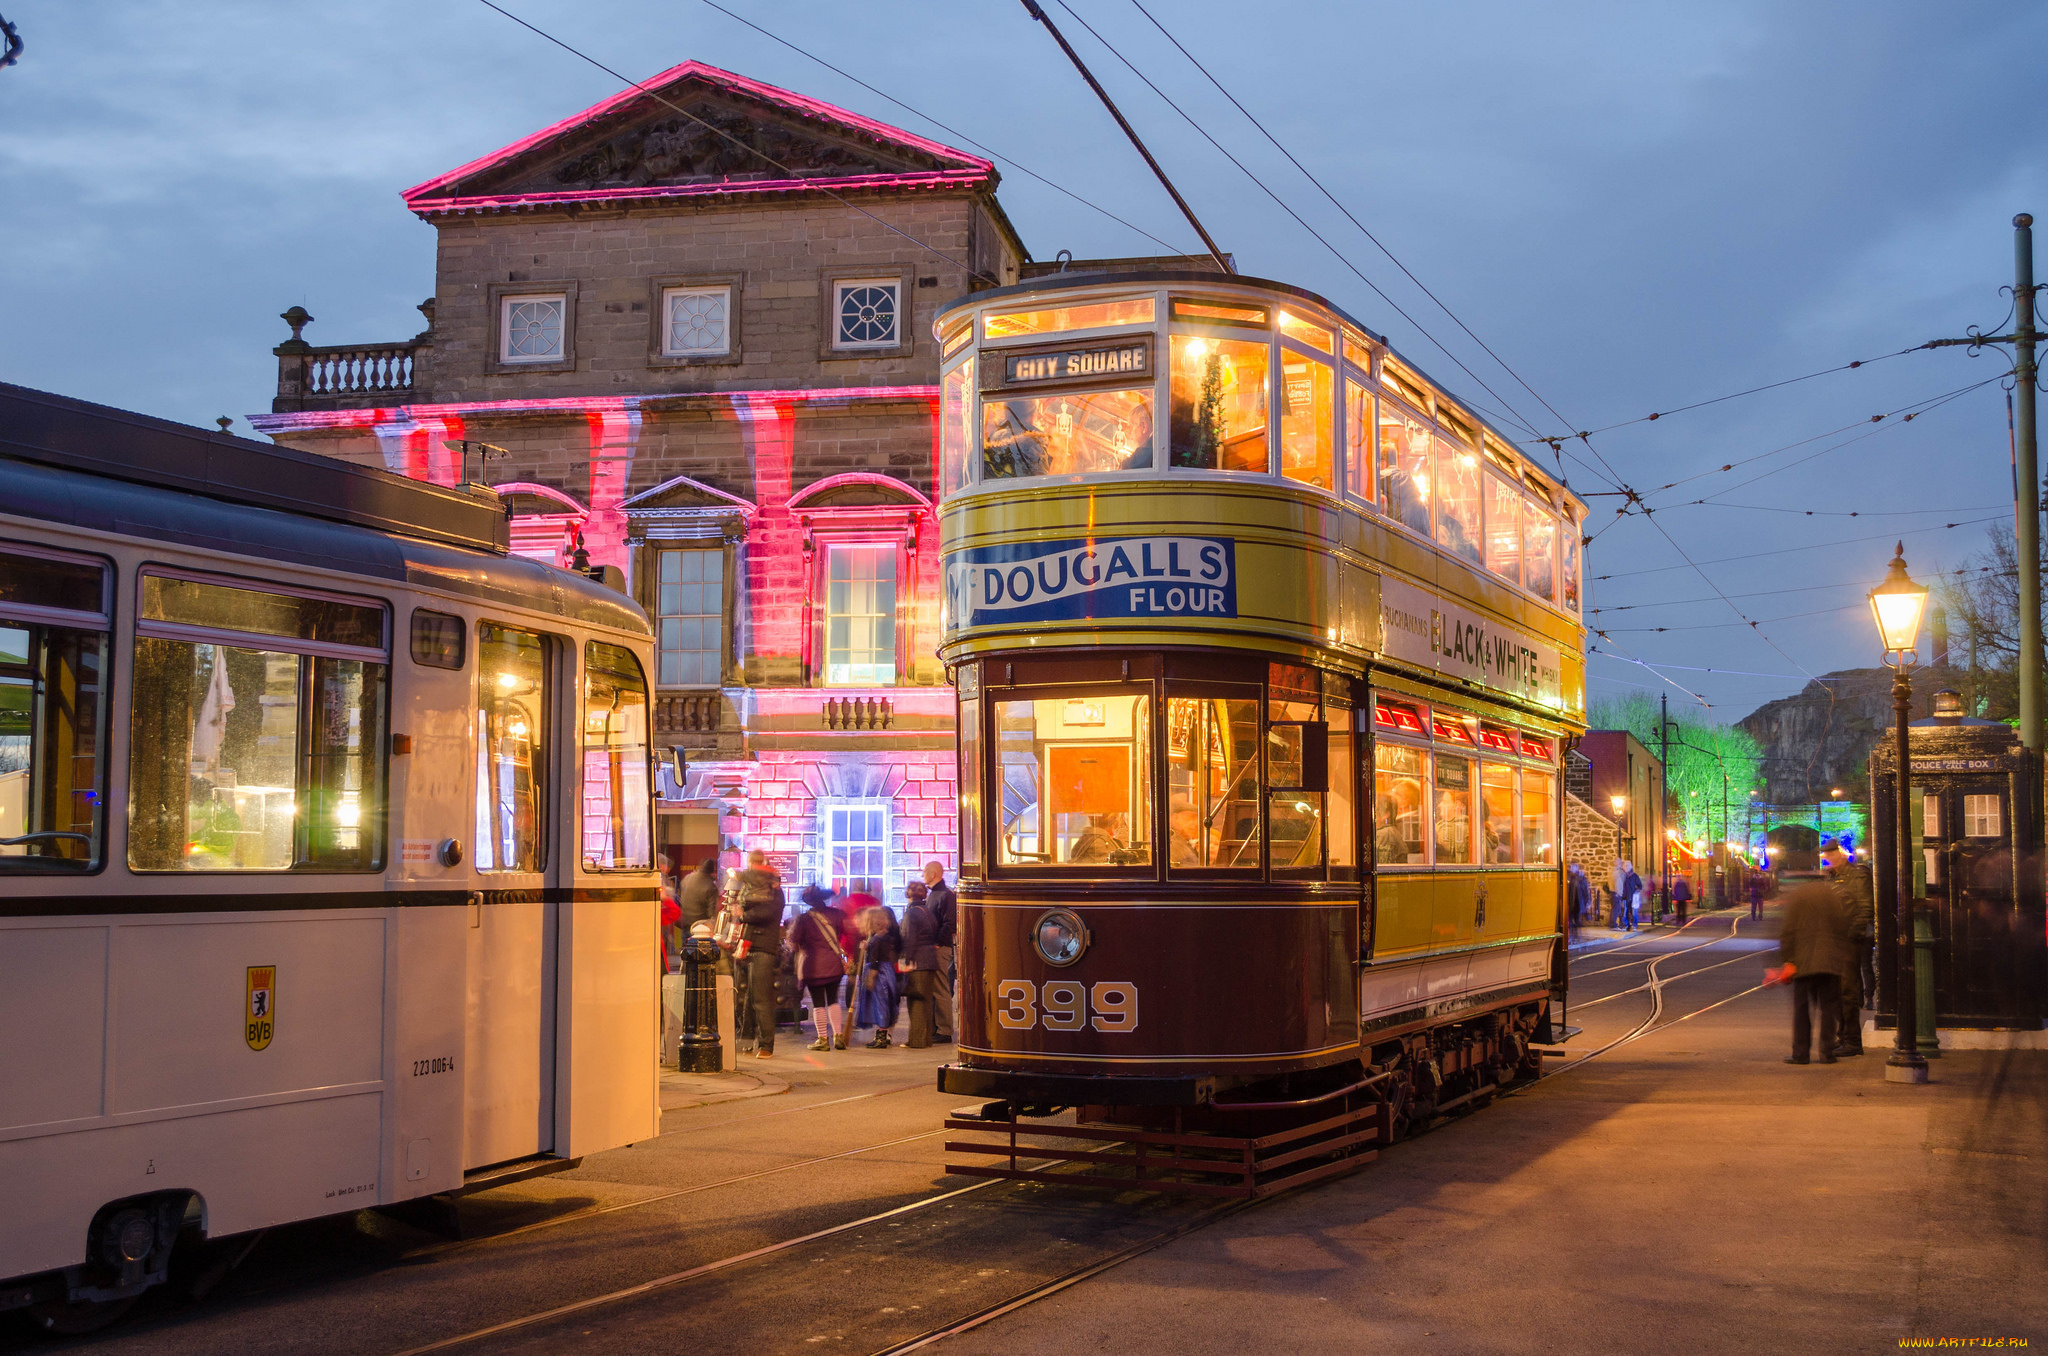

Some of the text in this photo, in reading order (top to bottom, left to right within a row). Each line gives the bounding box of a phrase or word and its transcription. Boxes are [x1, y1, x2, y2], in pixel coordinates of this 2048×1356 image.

[1016, 348, 1144, 379] CITY SQUARE
[1130, 588, 1226, 612] FLOUR
[1430, 609, 1486, 670] BLACK
[1494, 635, 1538, 687] WHITE
[1540, 665, 1559, 684] WHISKY
[1910, 761, 1941, 769] POLICE
[1968, 760, 1989, 768] BOX
[998, 979, 1139, 1032] 399
[248, 1020, 271, 1043] BVB
[431, 1056, 454, 1074] 006-4
